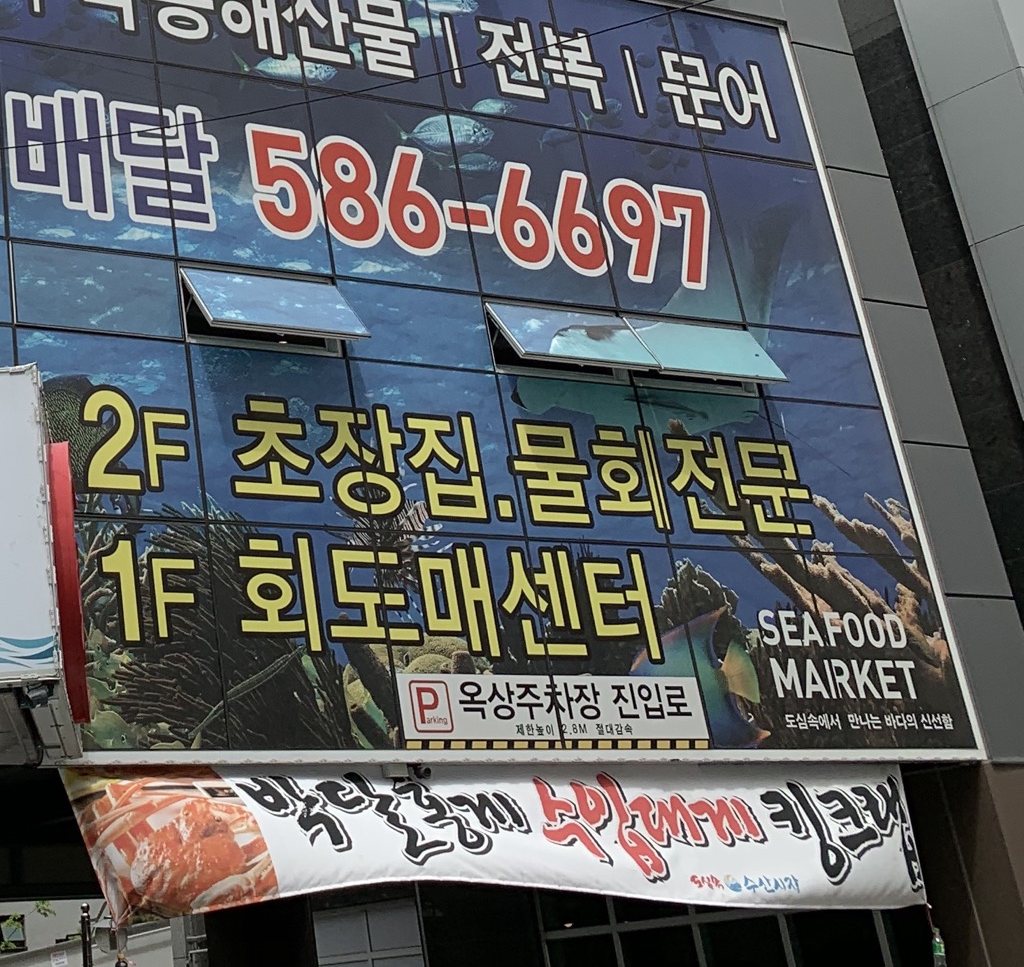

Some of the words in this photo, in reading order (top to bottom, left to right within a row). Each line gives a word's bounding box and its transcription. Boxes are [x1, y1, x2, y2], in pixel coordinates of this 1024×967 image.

[479, 18, 605, 111] 전복
[661, 49, 778, 142] 문어
[244, 121, 710, 291] 586-6697
[81, 386, 190, 494] 2F
[100, 534, 197, 645] 1F
[238, 533, 665, 664] 회도매센터
[757, 608, 908, 649] SEAFOOD
[458, 680, 602, 721] 옥상주차장
[612, 682, 693, 720] 진입로
[769, 657, 918, 700] MARKET
[515, 722, 555, 737] 제한높이
[784, 712, 842, 731] 도심속에서
[847, 713, 883, 731] 만나는
[884, 713, 918, 731] 바다의
[920, 713, 955, 731] 신선함
[236, 770, 533, 867] 박달홍게
